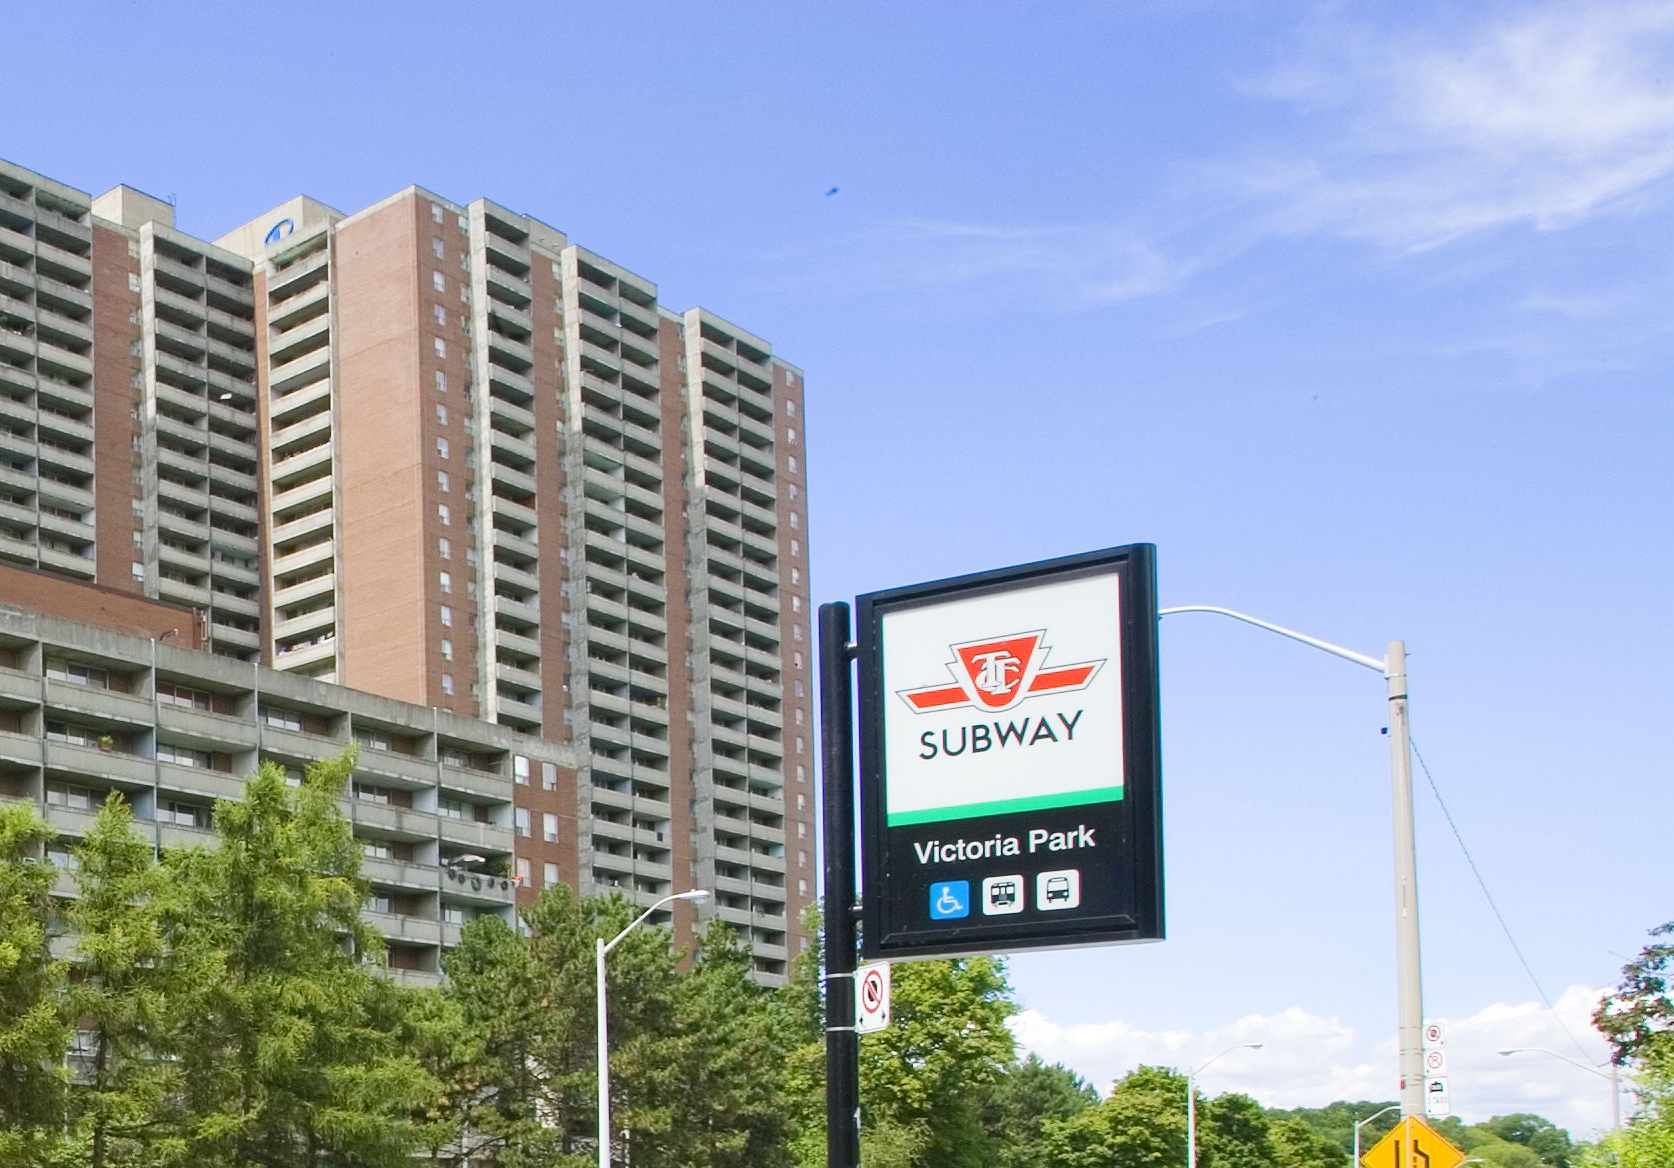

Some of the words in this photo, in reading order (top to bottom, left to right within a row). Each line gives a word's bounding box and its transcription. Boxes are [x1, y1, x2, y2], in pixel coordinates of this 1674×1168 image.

[919, 709, 1084, 760] SUBWAY
[914, 833, 1021, 865] Victoria
[1029, 825, 1096, 853] Park
